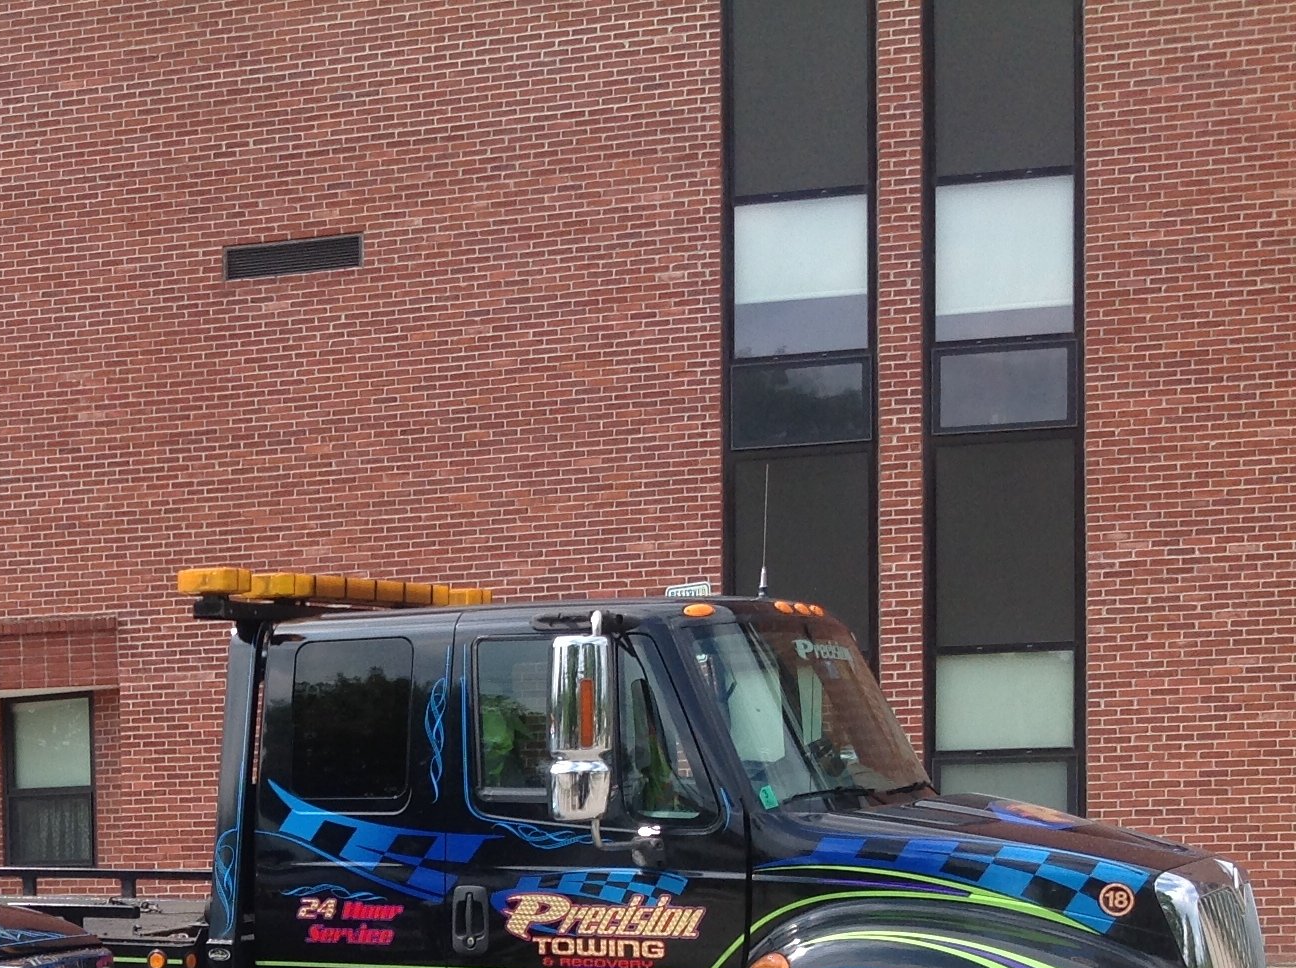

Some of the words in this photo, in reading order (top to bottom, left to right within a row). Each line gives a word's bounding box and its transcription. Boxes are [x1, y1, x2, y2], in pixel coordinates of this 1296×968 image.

[296, 897, 337, 919] 24
[341, 901, 404, 921] Hour
[1104, 890, 1128, 908] 18
[503, 892, 706, 941] Precision
[305, 923, 395, 945] Service
[532, 936, 666, 959] TOWING
[542, 957, 553, 966] &
